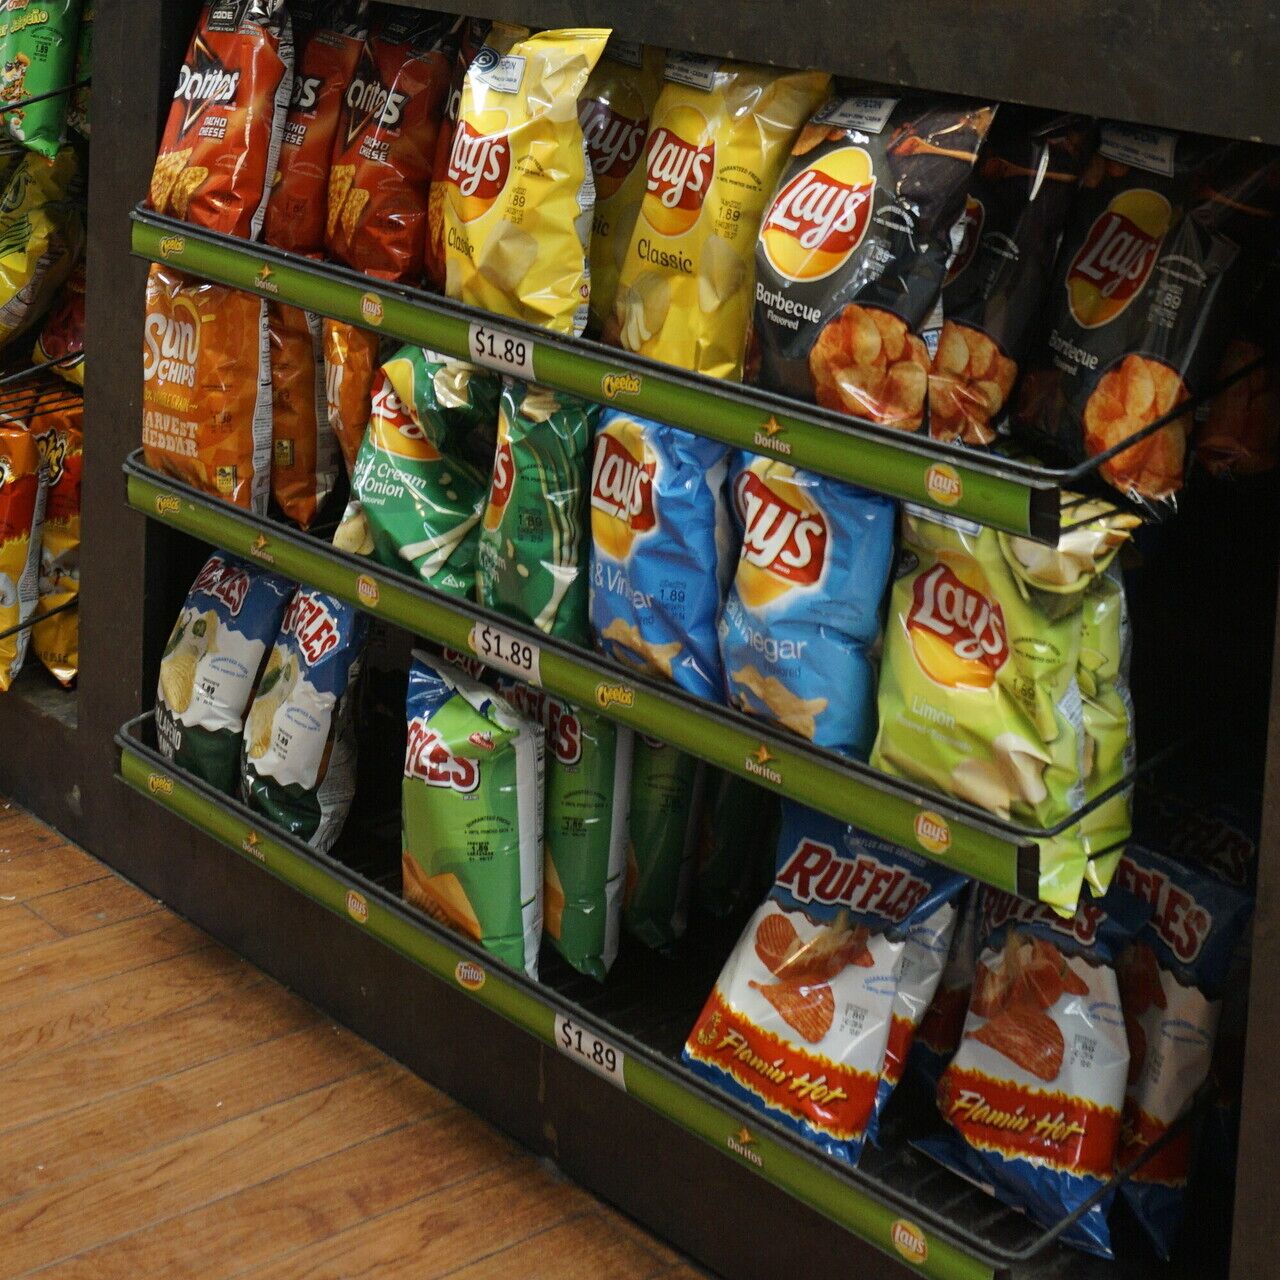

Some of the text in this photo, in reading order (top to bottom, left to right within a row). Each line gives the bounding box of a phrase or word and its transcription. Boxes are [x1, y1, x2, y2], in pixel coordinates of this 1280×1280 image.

[212, 10, 234, 20] CODE
[173, 64, 240, 100] Doritos
[198, 126, 226, 139] CHEESE
[203, 116, 228, 128] NACHO
[358, 146, 388, 163] CHEESE
[364, 135, 391, 151] NACHO
[447, 119, 506, 197] Lay's
[646, 129, 711, 209] Lay's
[768, 170, 868, 249] Lay's
[638, 237, 694, 275] Classic
[1075, 216, 1157, 298] Lay's
[254, 276, 279, 294] Doritos
[756, 282, 822, 324] Barbecue
[767, 310, 800, 331] Flavored
[143, 312, 201, 381] Sun
[474, 326, 528, 367] $1.89
[1050, 328, 1100, 373] Barbecue
[158, 359, 196, 388] CHIPS
[601, 372, 641, 398] Cheetos
[753, 431, 792, 456] Doritos
[364, 477, 405, 500] Onion
[376, 462, 427, 490] Cream
[592, 435, 649, 521] Lay's
[658, 587, 686, 604] 1.89
[912, 566, 1005, 661] Lay's
[480, 623, 533, 671] $1.89
[596, 683, 635, 709] Cheetos
[912, 695, 957, 729] Limón
[745, 758, 782, 785] Doritos
[776, 837, 930, 922] RUFFLES
[456, 961, 486, 985] Fritos
[561, 1021, 618, 1072] $1.89
[715, 1027, 848, 1107] Flamin' Hot
[952, 1087, 1086, 1142] Flamin' Hot
[726, 1134, 763, 1168] Doritos
